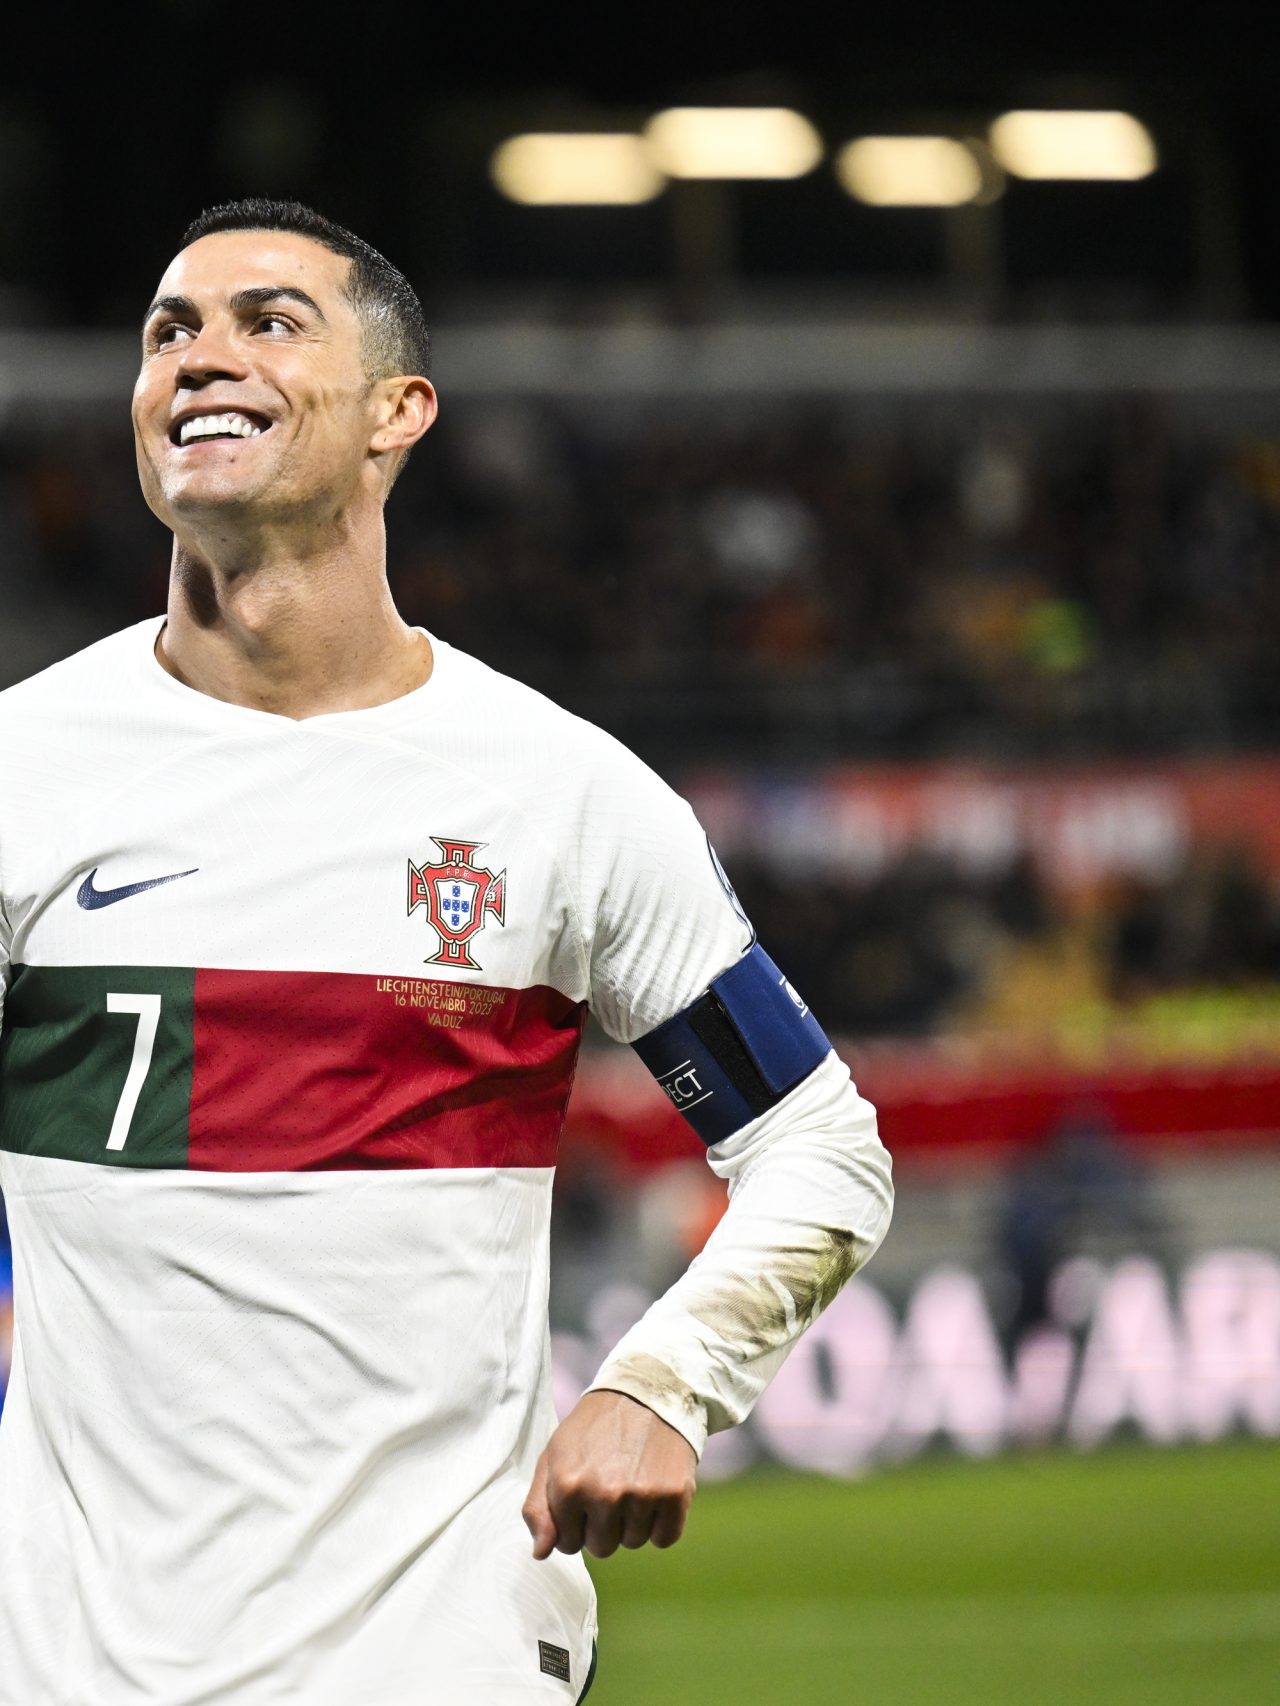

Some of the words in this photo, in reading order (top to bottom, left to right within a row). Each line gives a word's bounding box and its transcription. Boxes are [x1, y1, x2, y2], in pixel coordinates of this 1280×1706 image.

[395, 994, 407, 1006] 16
[410, 995, 466, 1012] NOVEMBRO
[469, 1002, 493, 1015] 2023
[427, 1012, 464, 1029] VADUZ
[105, 992, 162, 1151] 7
